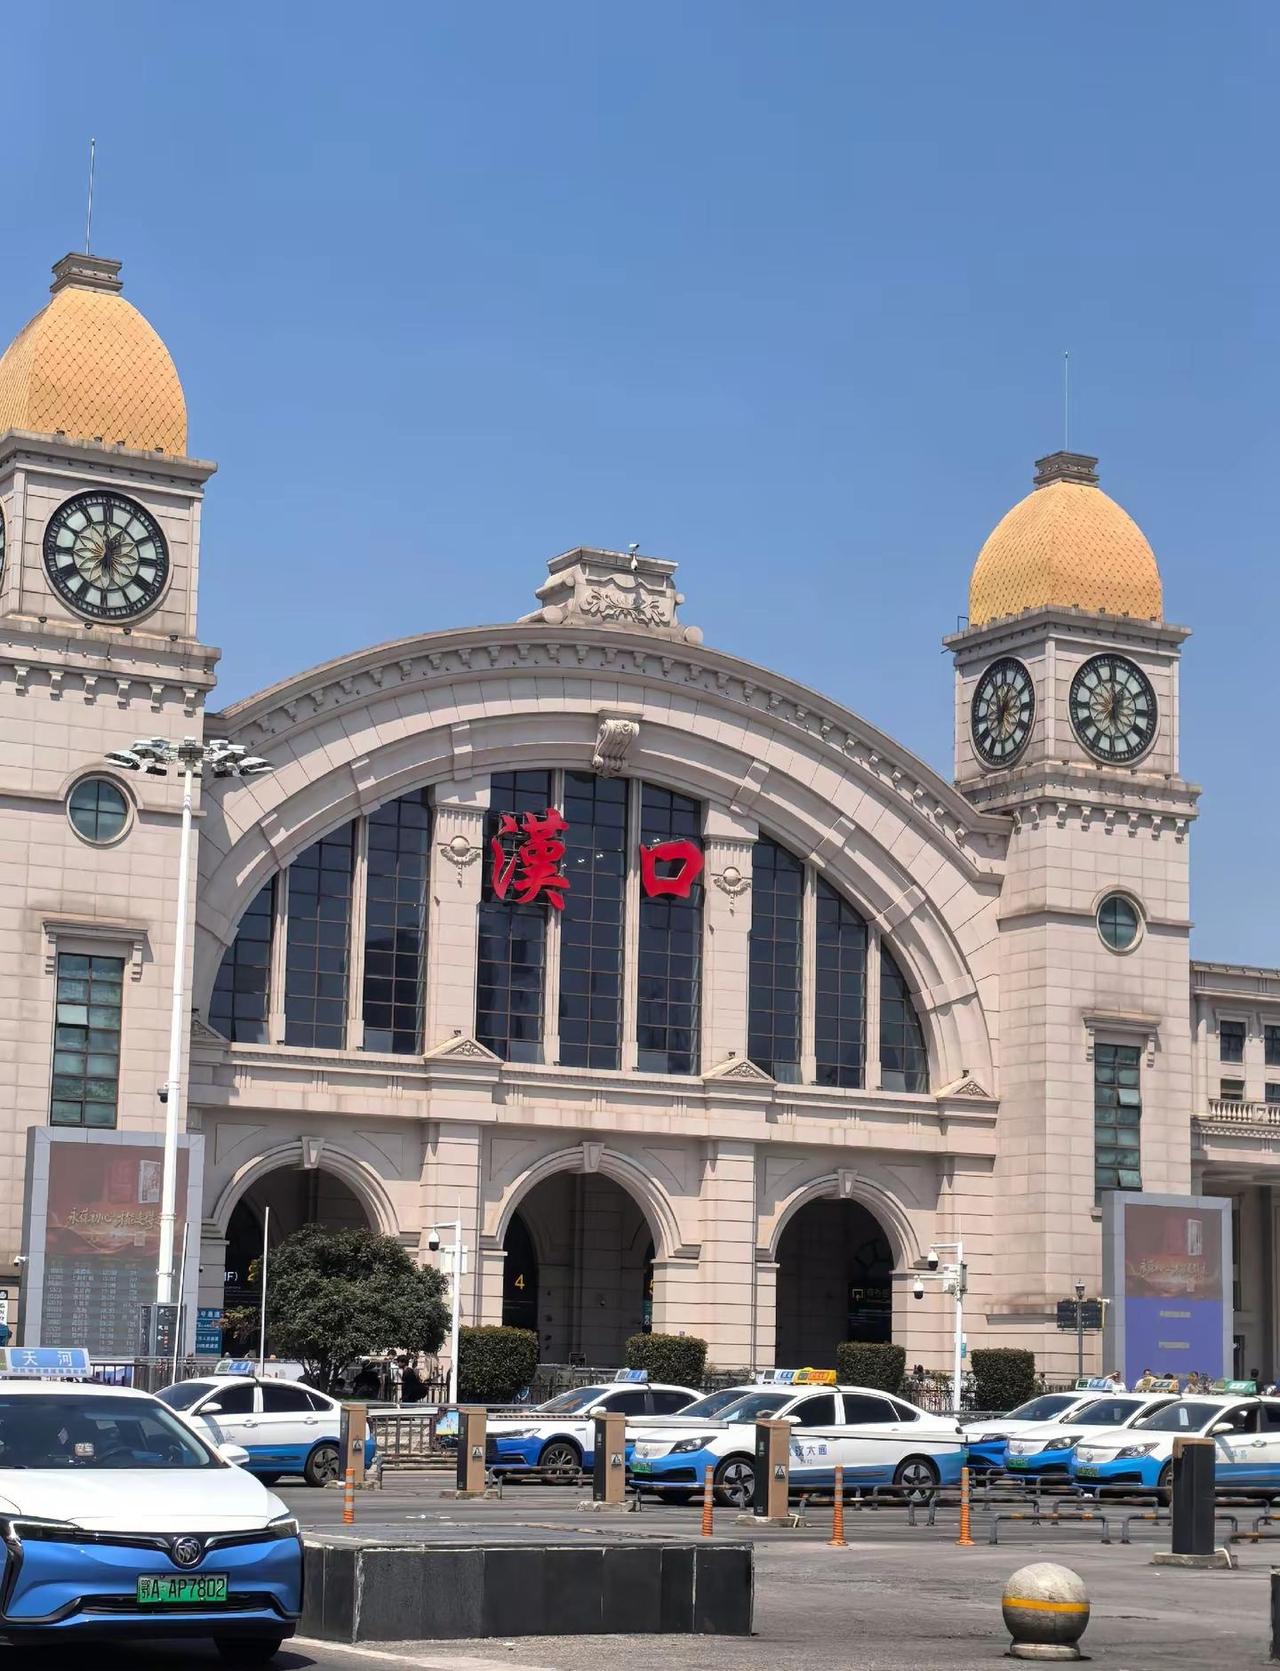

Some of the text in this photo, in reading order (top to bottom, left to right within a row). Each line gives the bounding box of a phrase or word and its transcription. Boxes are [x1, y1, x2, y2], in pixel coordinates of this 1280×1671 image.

[491, 807, 705, 912] 漢口
[514, 1273, 526, 1290] 4
[22, 1350, 73, 1367] 天河
[168, 1578, 225, 1598] AP7802
